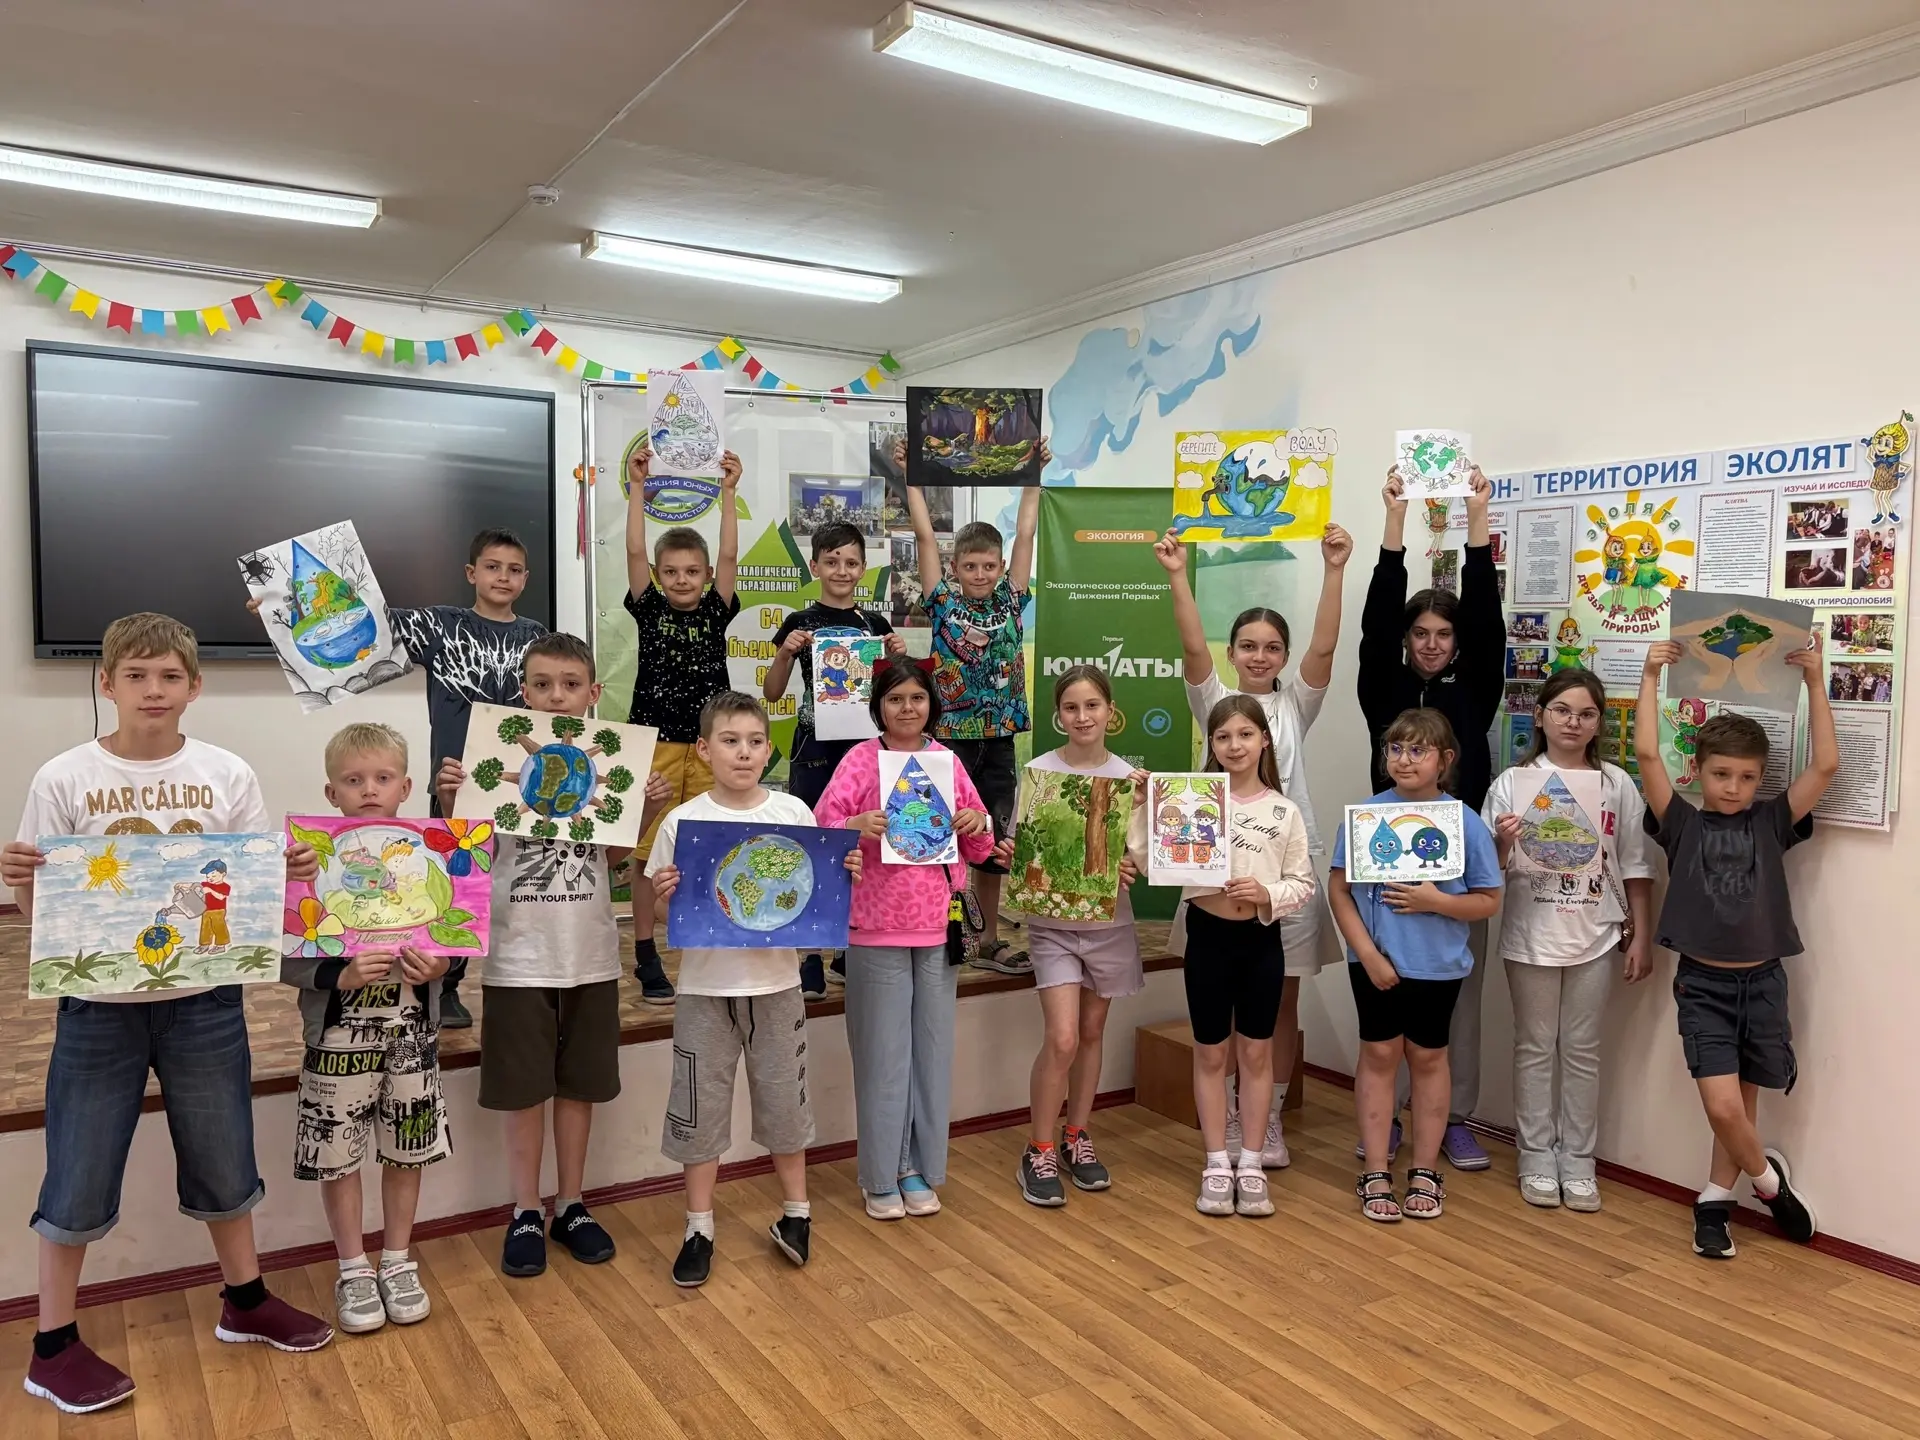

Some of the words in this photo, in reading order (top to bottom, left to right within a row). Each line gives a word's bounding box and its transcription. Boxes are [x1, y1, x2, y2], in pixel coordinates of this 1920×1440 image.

[1180, 442, 1218, 453] БЕРЕГИТЕ
[1289, 435, 1327, 452] ВОДУ
[1533, 458, 1698, 494] ТЕРРИТОРИЯ
[1727, 443, 1852, 478] ЭКОЛЯТ
[683, 480, 714, 493] ЮНЫХ
[1784, 482, 1818, 493] ИЗУЧАЙ
[1819, 482, 1826, 491] И
[644, 502, 708, 520] АТУРАЛИСТОВ
[1087, 532, 1144, 540] ЭКОЛОГИЯ
[737, 566, 802, 578] КОЛОГИЧЕСКОЕ
[736, 581, 799, 592] ОБРАЗОВАНИЕ
[853, 586, 872, 597] ТНО-
[1045, 581, 1121, 590] Экологическое
[1122, 582, 1172, 591] сообщест
[1068, 592, 1120, 600] Движения
[1121, 592, 1160, 601] Первых
[1577, 574, 1605, 614] ДРУЗЬЯ
[1623, 574, 1689, 623] ЗАЩИТНКИ
[1817, 597, 1893, 606] ПРИРОДОЛЮБИЯ
[759, 608, 783, 630] 64
[1601, 620, 1661, 635] ПРИРОДЫ
[760, 695, 796, 715] етей
[86, 786, 137, 816] MAR
[1233, 813, 1281, 840] Lucky
[510, 894, 538, 903] BURN
[540, 894, 567, 902] YOUR
[569, 893, 594, 902] SPIRIT
[1566, 898, 1599, 906] Everything
[317, 1053, 349, 1074] BOY
[352, 1052, 382, 1073] ARS
